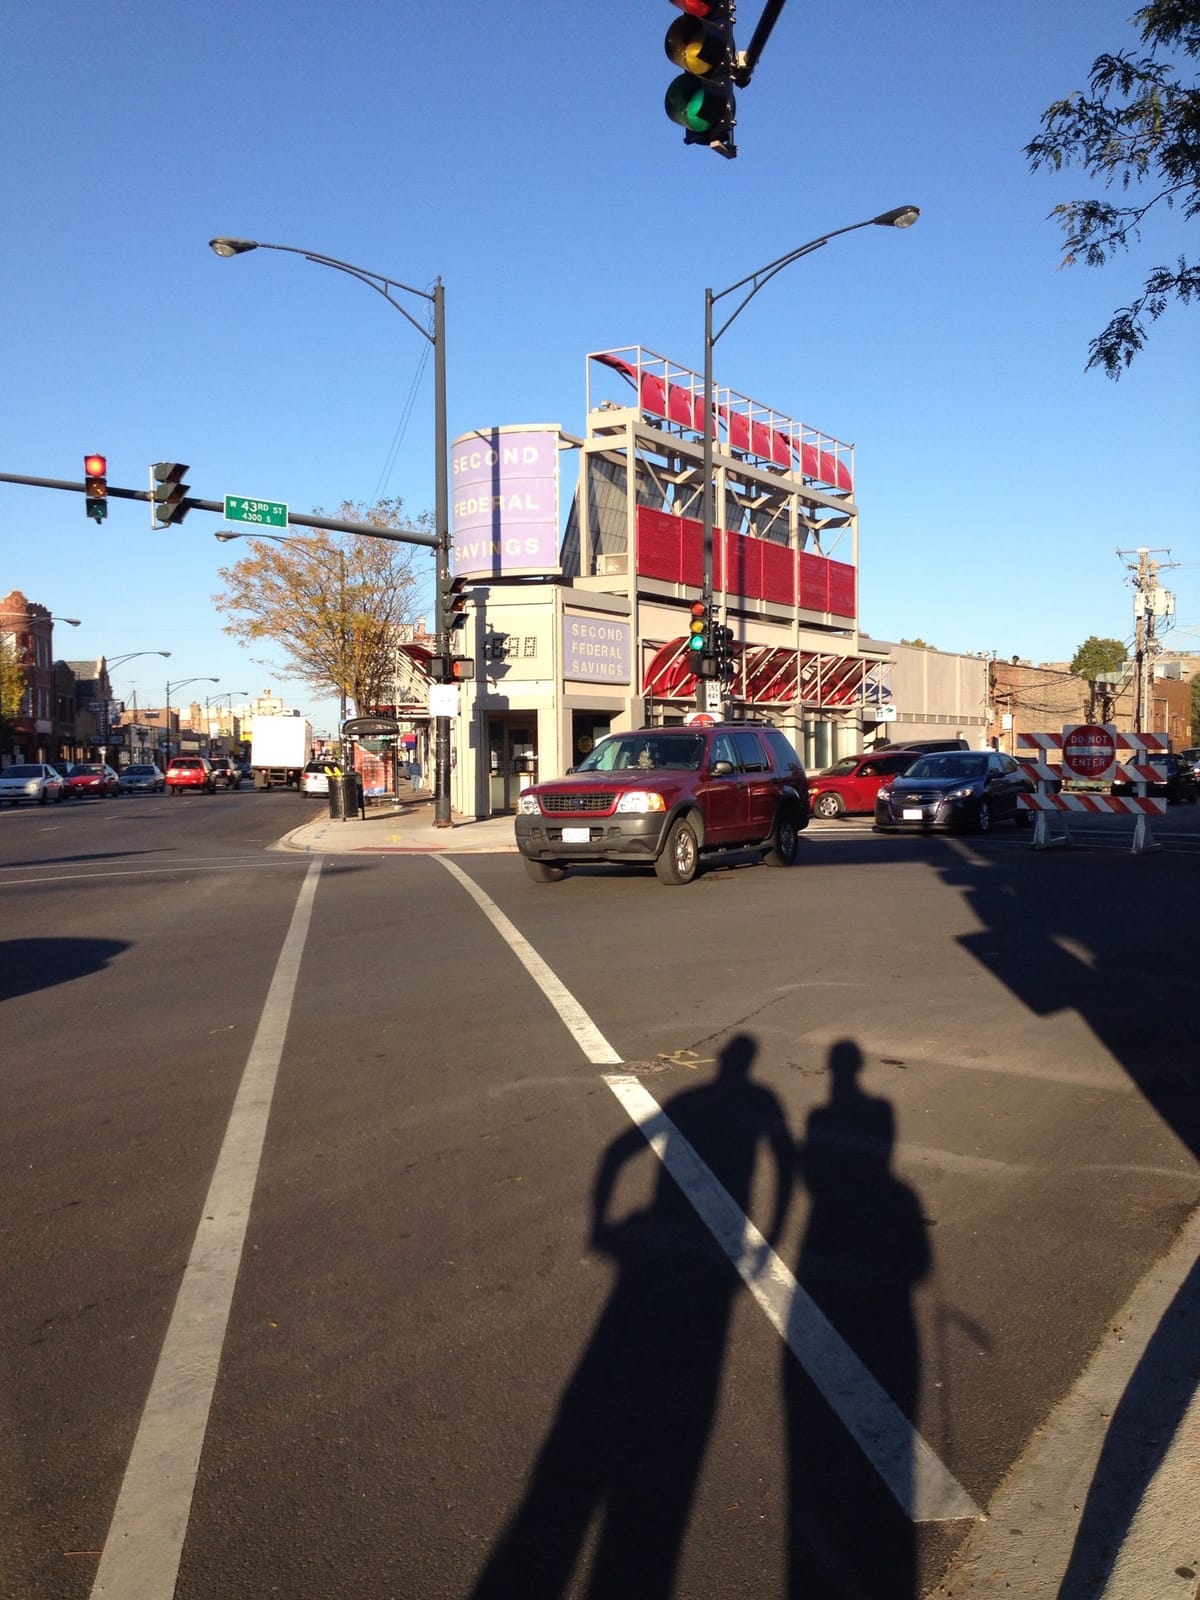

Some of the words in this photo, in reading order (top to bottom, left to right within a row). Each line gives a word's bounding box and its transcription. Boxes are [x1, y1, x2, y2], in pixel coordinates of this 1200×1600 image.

[453, 446, 539, 475] SECOND
[229, 500, 237, 508] W
[241, 500, 269, 512] 43RD
[273, 507, 283, 515] ST
[454, 493, 540, 518] FEDERAL
[242, 512, 262, 522] 4300
[265, 515, 271, 523] S
[454, 537, 540, 563] SAVINGS
[571, 623, 623, 641] SECOND
[571, 642, 623, 659] FEDERAL
[571, 660, 624, 677] SAVINGS
[1071, 735, 1084, 744] DO
[1088, 735, 1108, 744] NOT
[1072, 758, 1105, 767] ENTER
